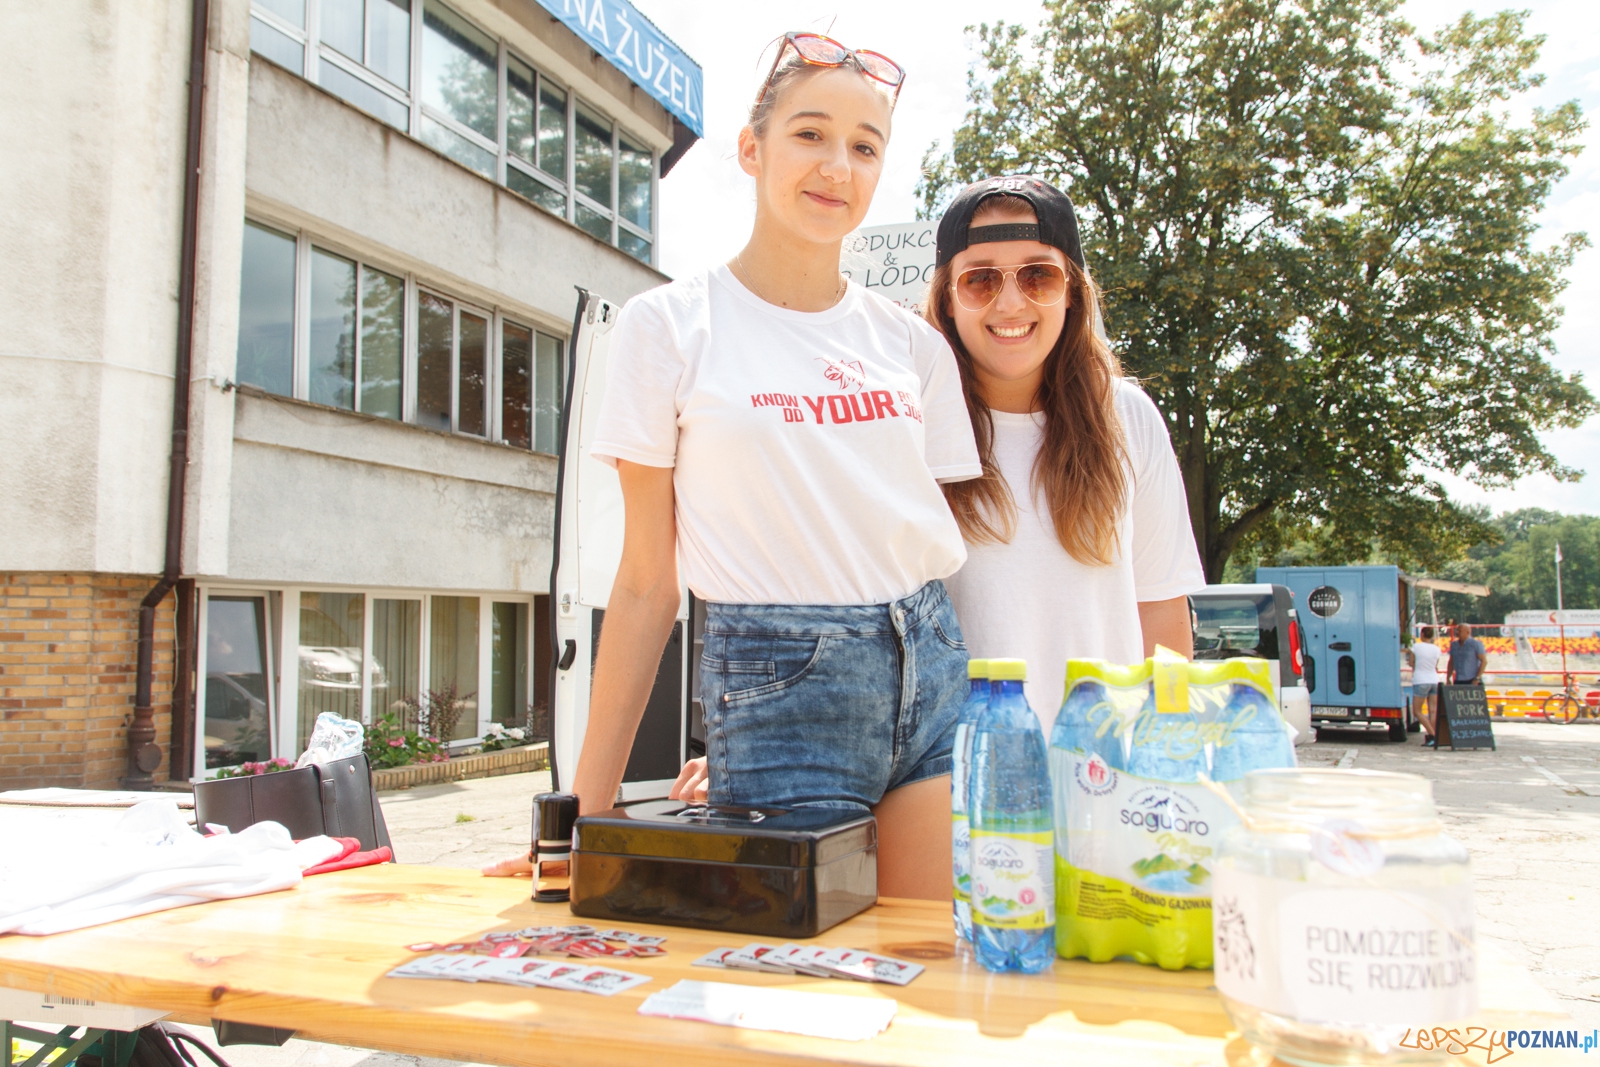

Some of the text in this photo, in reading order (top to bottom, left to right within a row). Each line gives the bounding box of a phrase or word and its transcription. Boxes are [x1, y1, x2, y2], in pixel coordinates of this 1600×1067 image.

[564, 0, 697, 122] NA ŻUŻEL
[846, 229, 937, 252] ODUKC
[883, 252, 898, 266] &
[750, 393, 799, 408] KNOW
[802, 390, 900, 425] YOUR
[783, 407, 805, 423] DO
[1449, 690, 1486, 701] PULLED
[1456, 703, 1485, 717] PORK
[1120, 809, 1209, 836] saguaro
[1168, 898, 1213, 910] GAZOWAN
[1306, 956, 1354, 993] SIĘ
